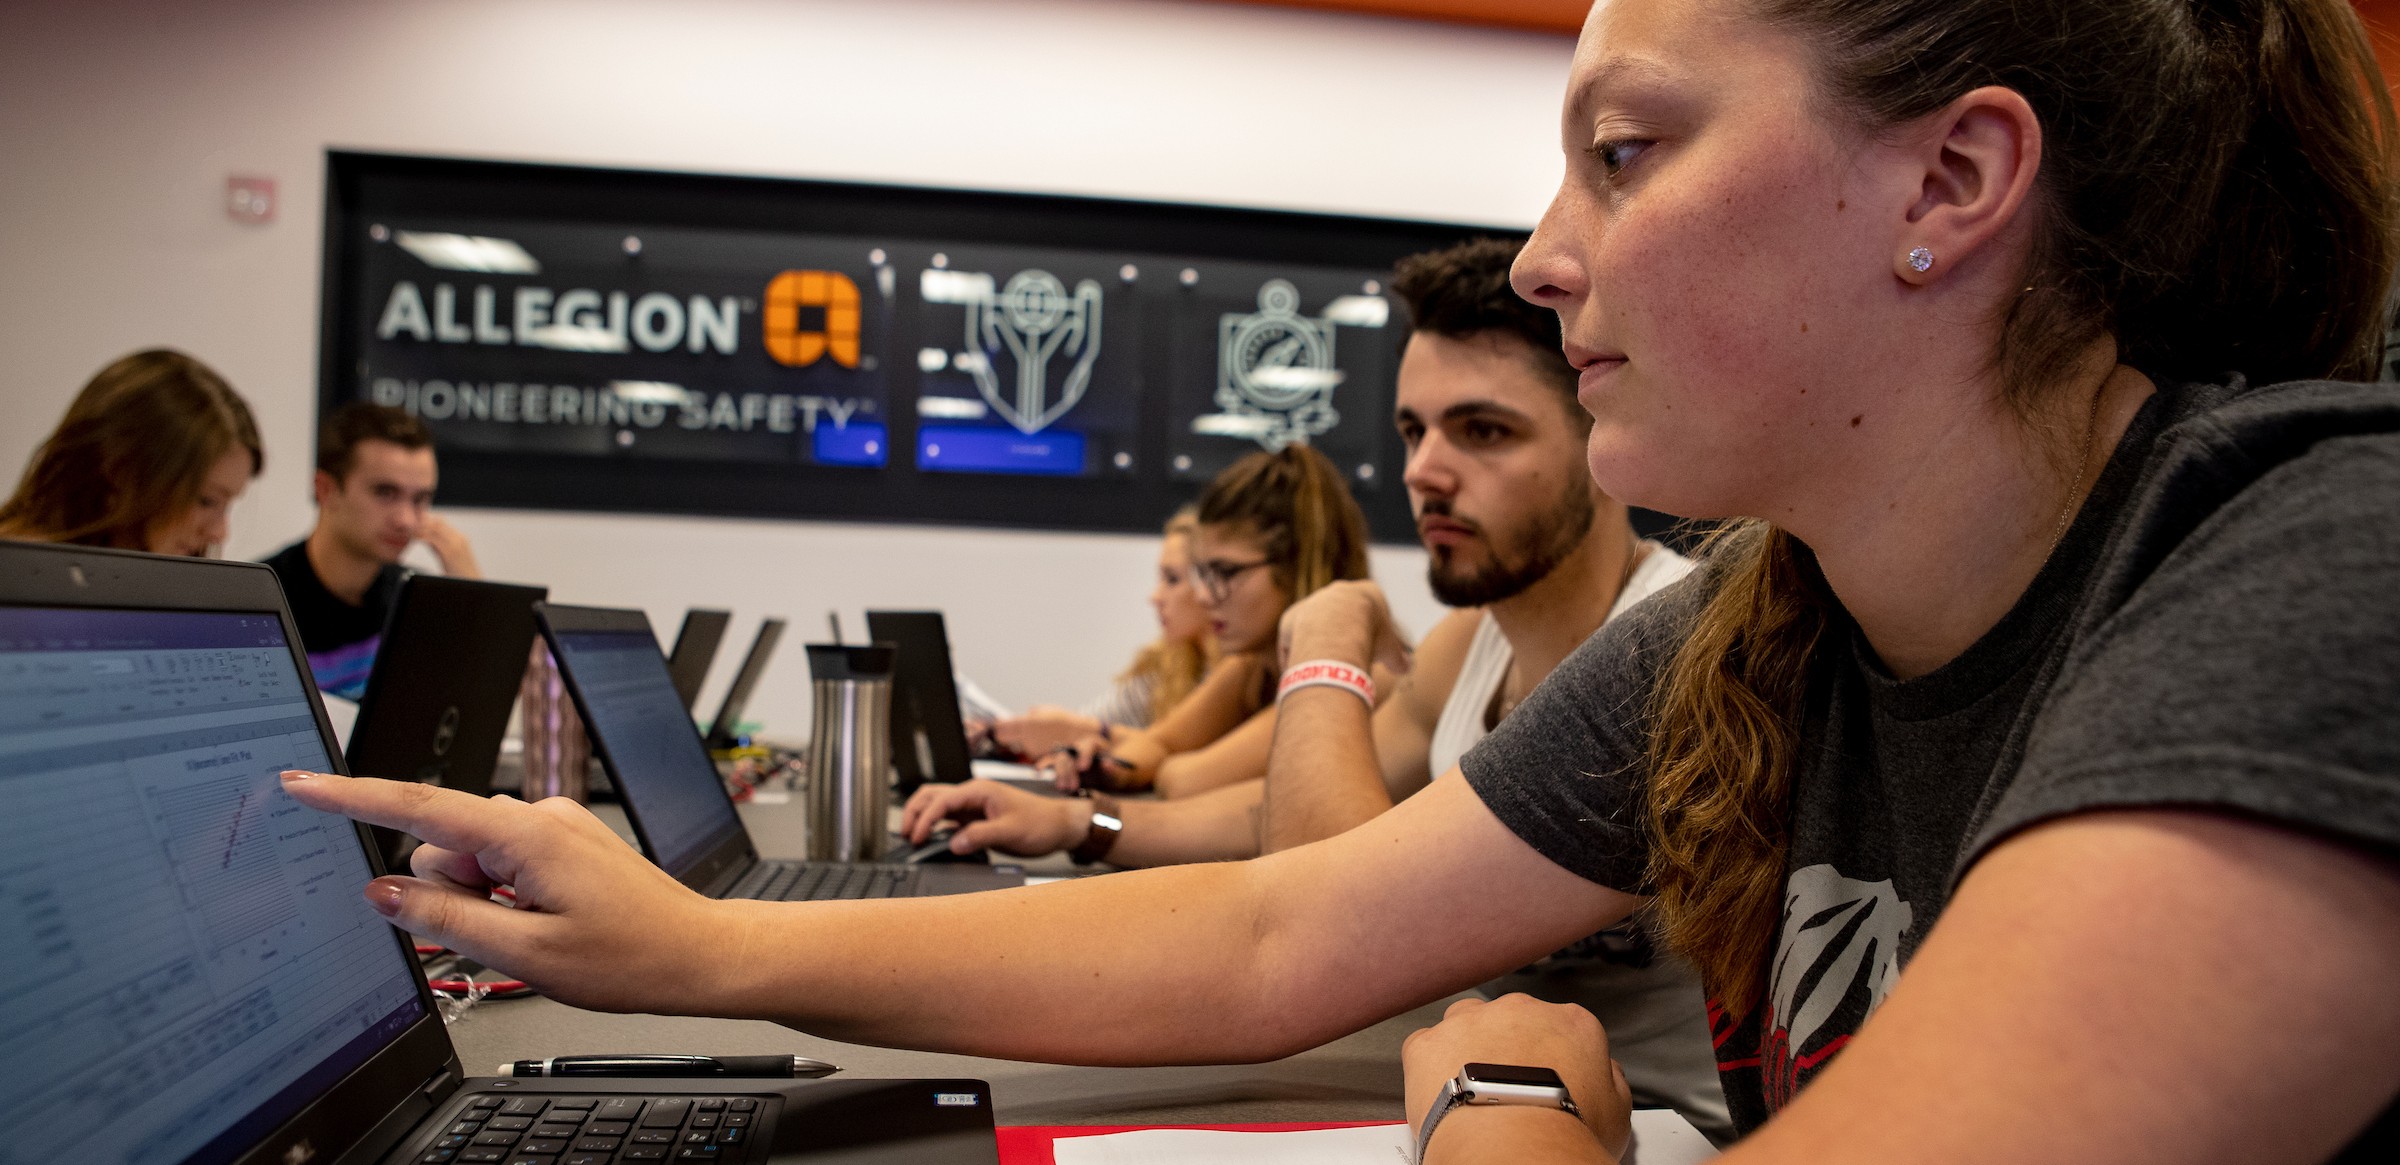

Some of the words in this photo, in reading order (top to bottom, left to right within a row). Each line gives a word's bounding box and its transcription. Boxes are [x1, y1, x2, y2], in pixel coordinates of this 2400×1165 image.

[377, 282, 740, 355] ALLEGION
[371, 378, 666, 428] PIONEERING
[675, 390, 859, 434] SAFETY
